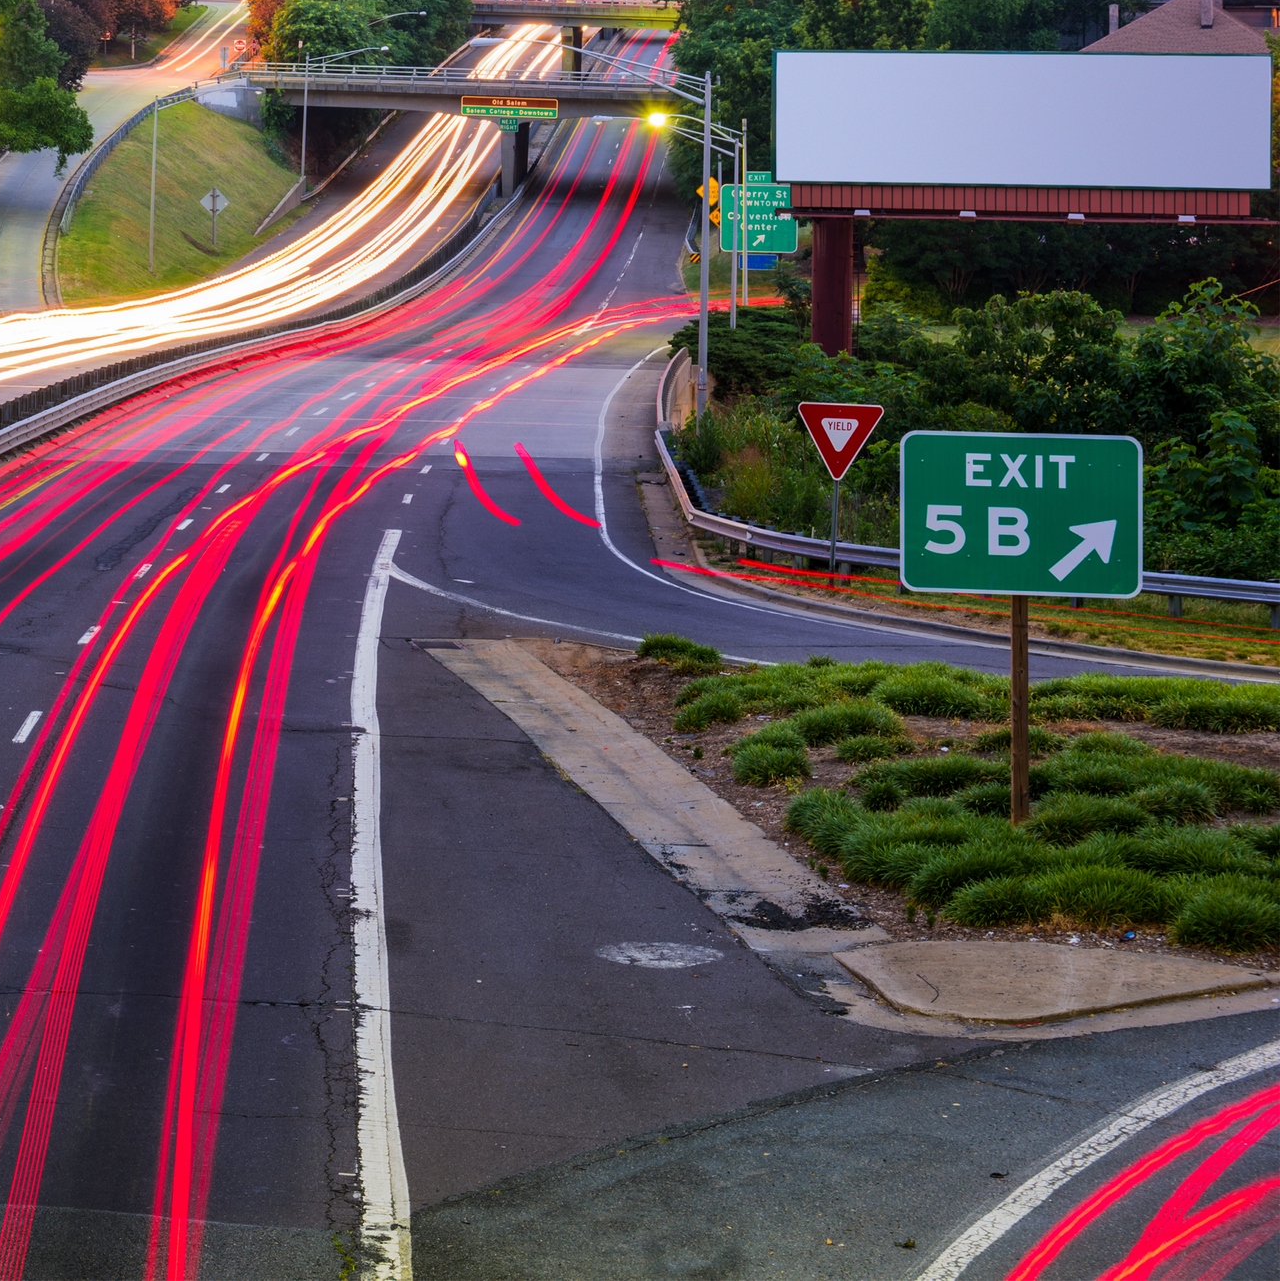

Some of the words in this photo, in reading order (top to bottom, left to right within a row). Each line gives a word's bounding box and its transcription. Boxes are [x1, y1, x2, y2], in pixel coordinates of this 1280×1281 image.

[775, 190, 787, 198] St
[727, 211, 791, 220] Coventi
[827, 421, 853, 431] YIELD
[965, 452, 1076, 489] EXIT
